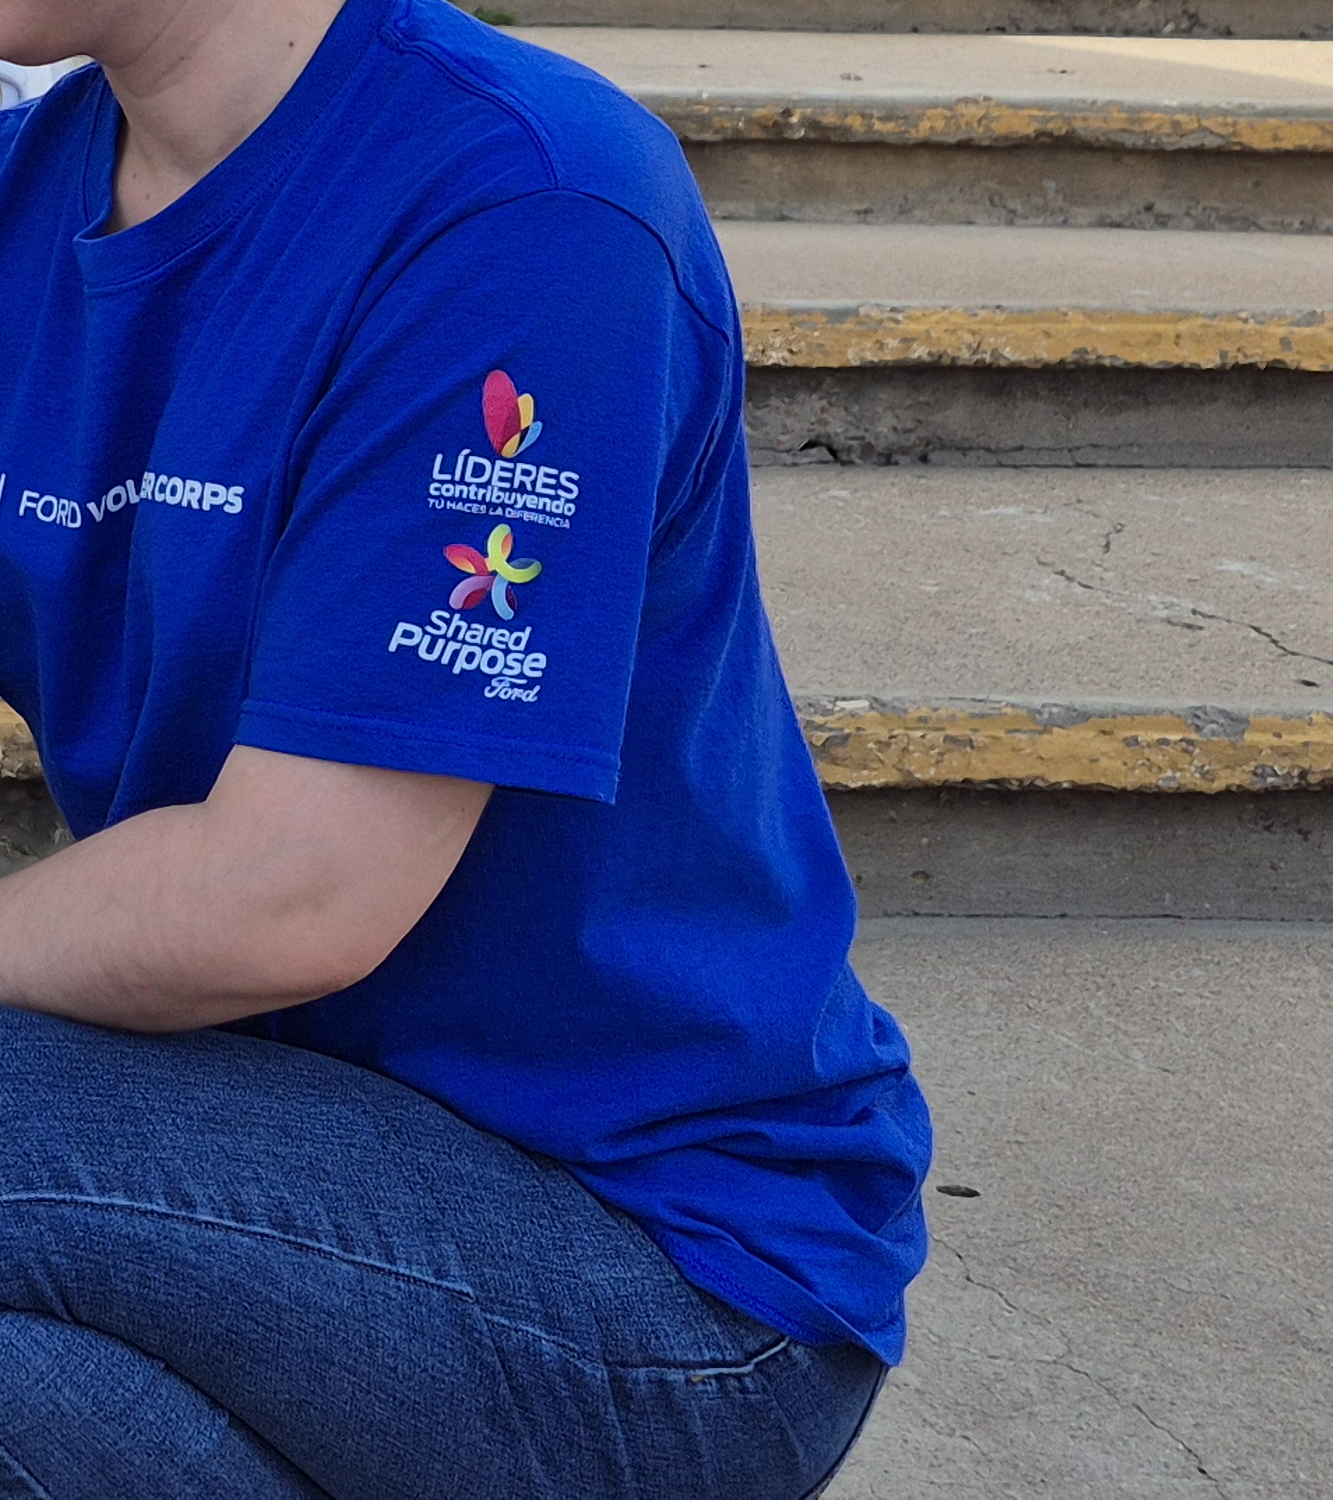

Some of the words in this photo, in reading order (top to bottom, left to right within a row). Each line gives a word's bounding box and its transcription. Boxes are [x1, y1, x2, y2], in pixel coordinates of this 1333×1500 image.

[432, 448, 580, 499] LÍDERES
[19, 489, 82, 529] FORD
[154, 475, 245, 514] CORPS
[429, 482, 576, 516] contribuyendo
[446, 500, 486, 513] HACES
[488, 506, 503, 516] LA
[505, 507, 571, 529] DIFERENCIA
[388, 622, 547, 678] Purpose
[424, 610, 532, 652] Shared
[484, 677, 541, 703] Ford
